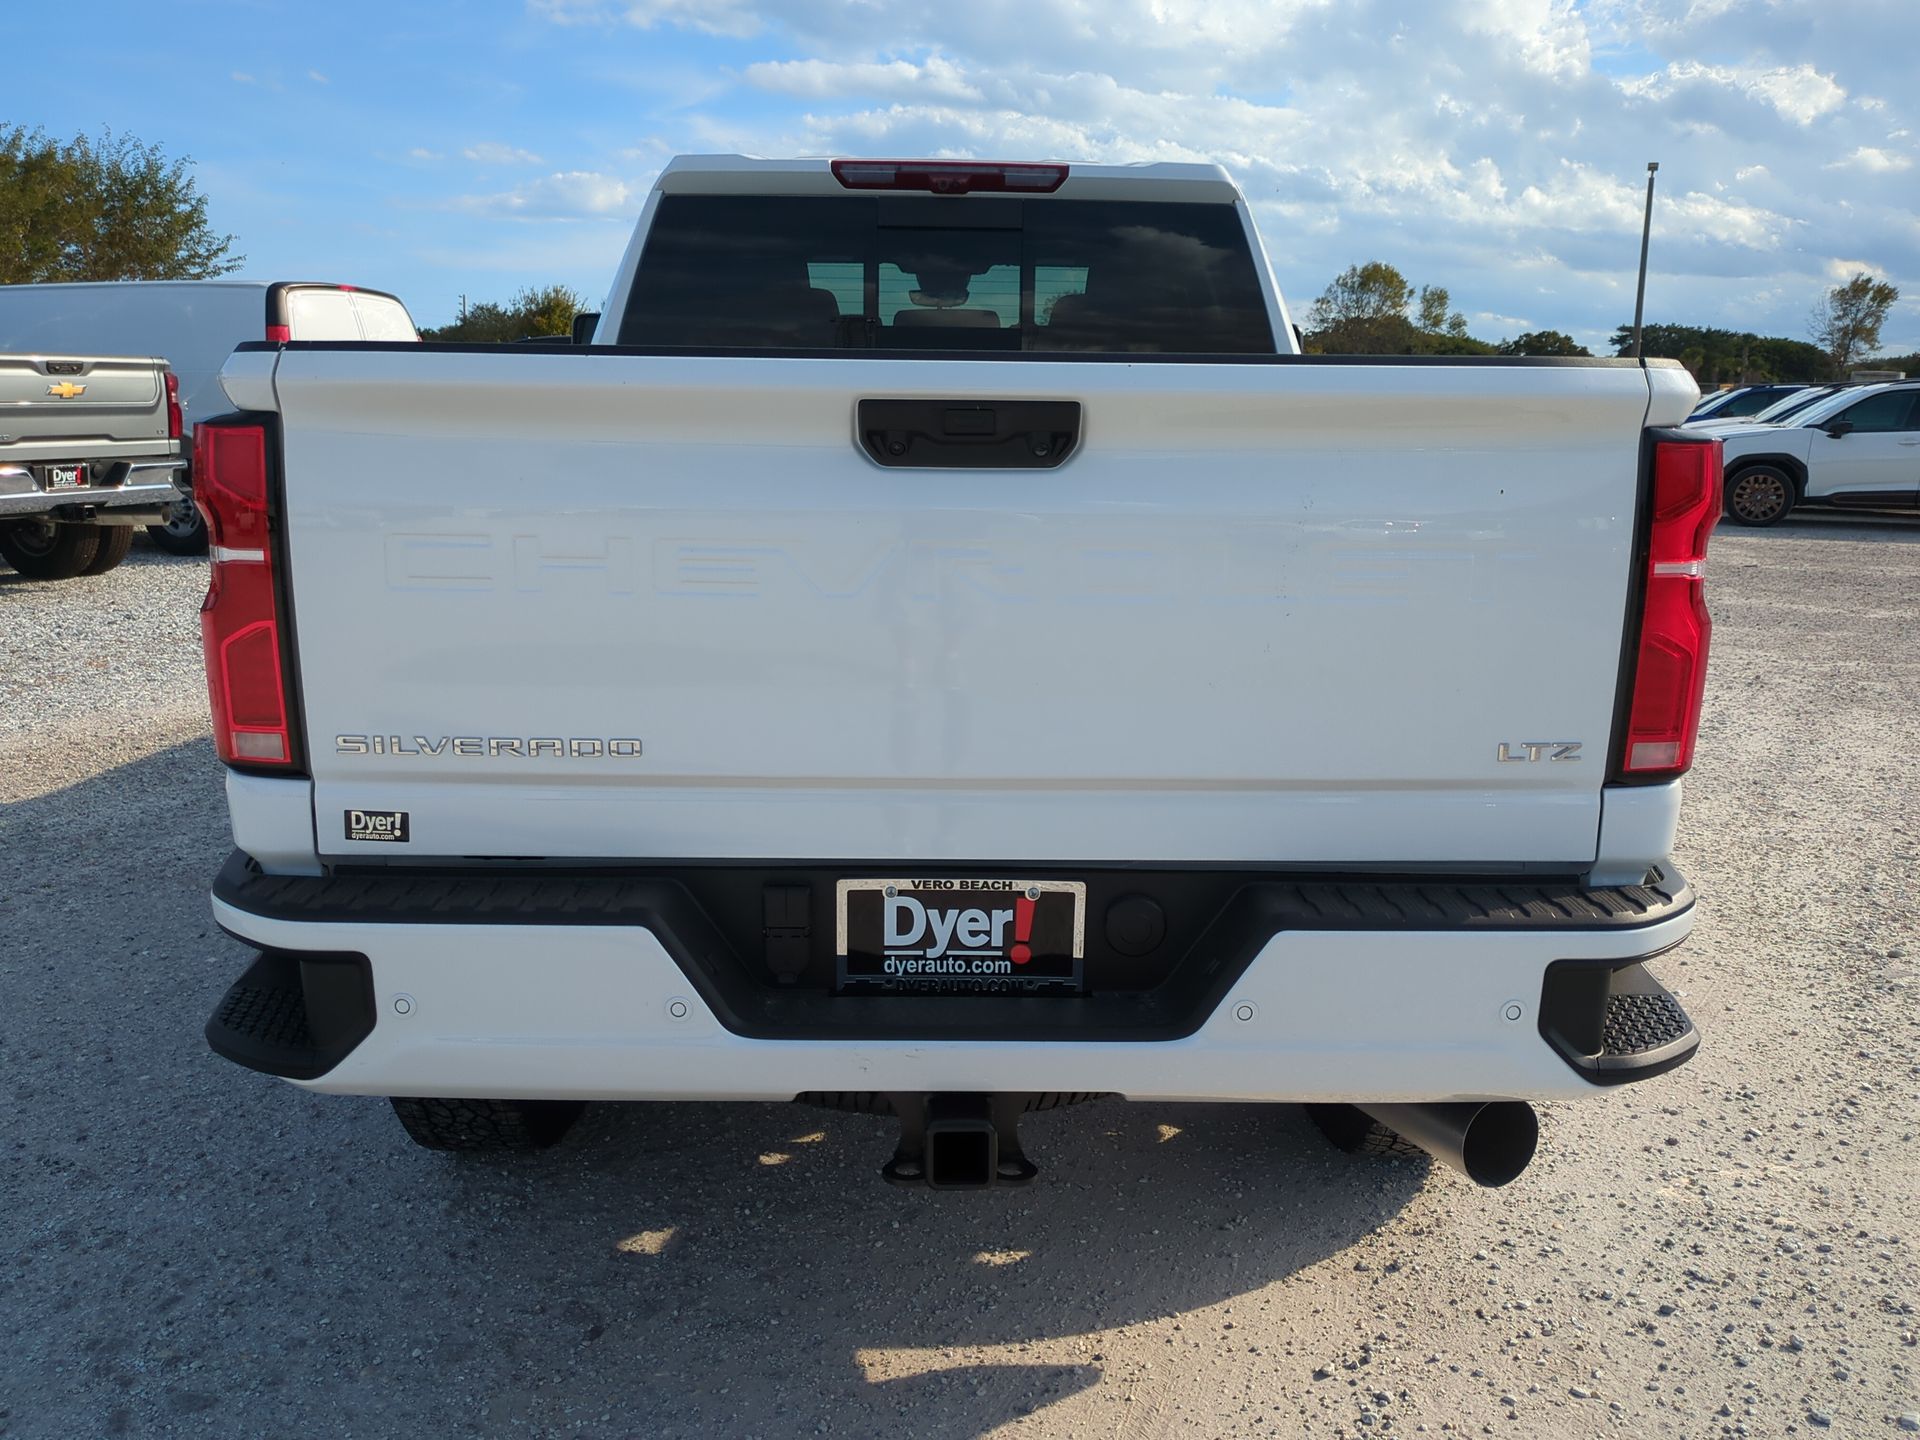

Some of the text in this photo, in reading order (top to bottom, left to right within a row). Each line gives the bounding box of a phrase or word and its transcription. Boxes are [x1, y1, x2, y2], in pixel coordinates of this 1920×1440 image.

[53, 467, 82, 484] Dyer!
[335, 735, 643, 758] SILVERADO
[1497, 742, 1582, 762] LTZ
[351, 811, 402, 837] Dyer!
[351, 832, 395, 840] dyerauto.com
[911, 880, 1013, 891] VERO BEACH
[884, 895, 1036, 965] Dyer!
[883, 957, 1012, 976] dyerauto.com
